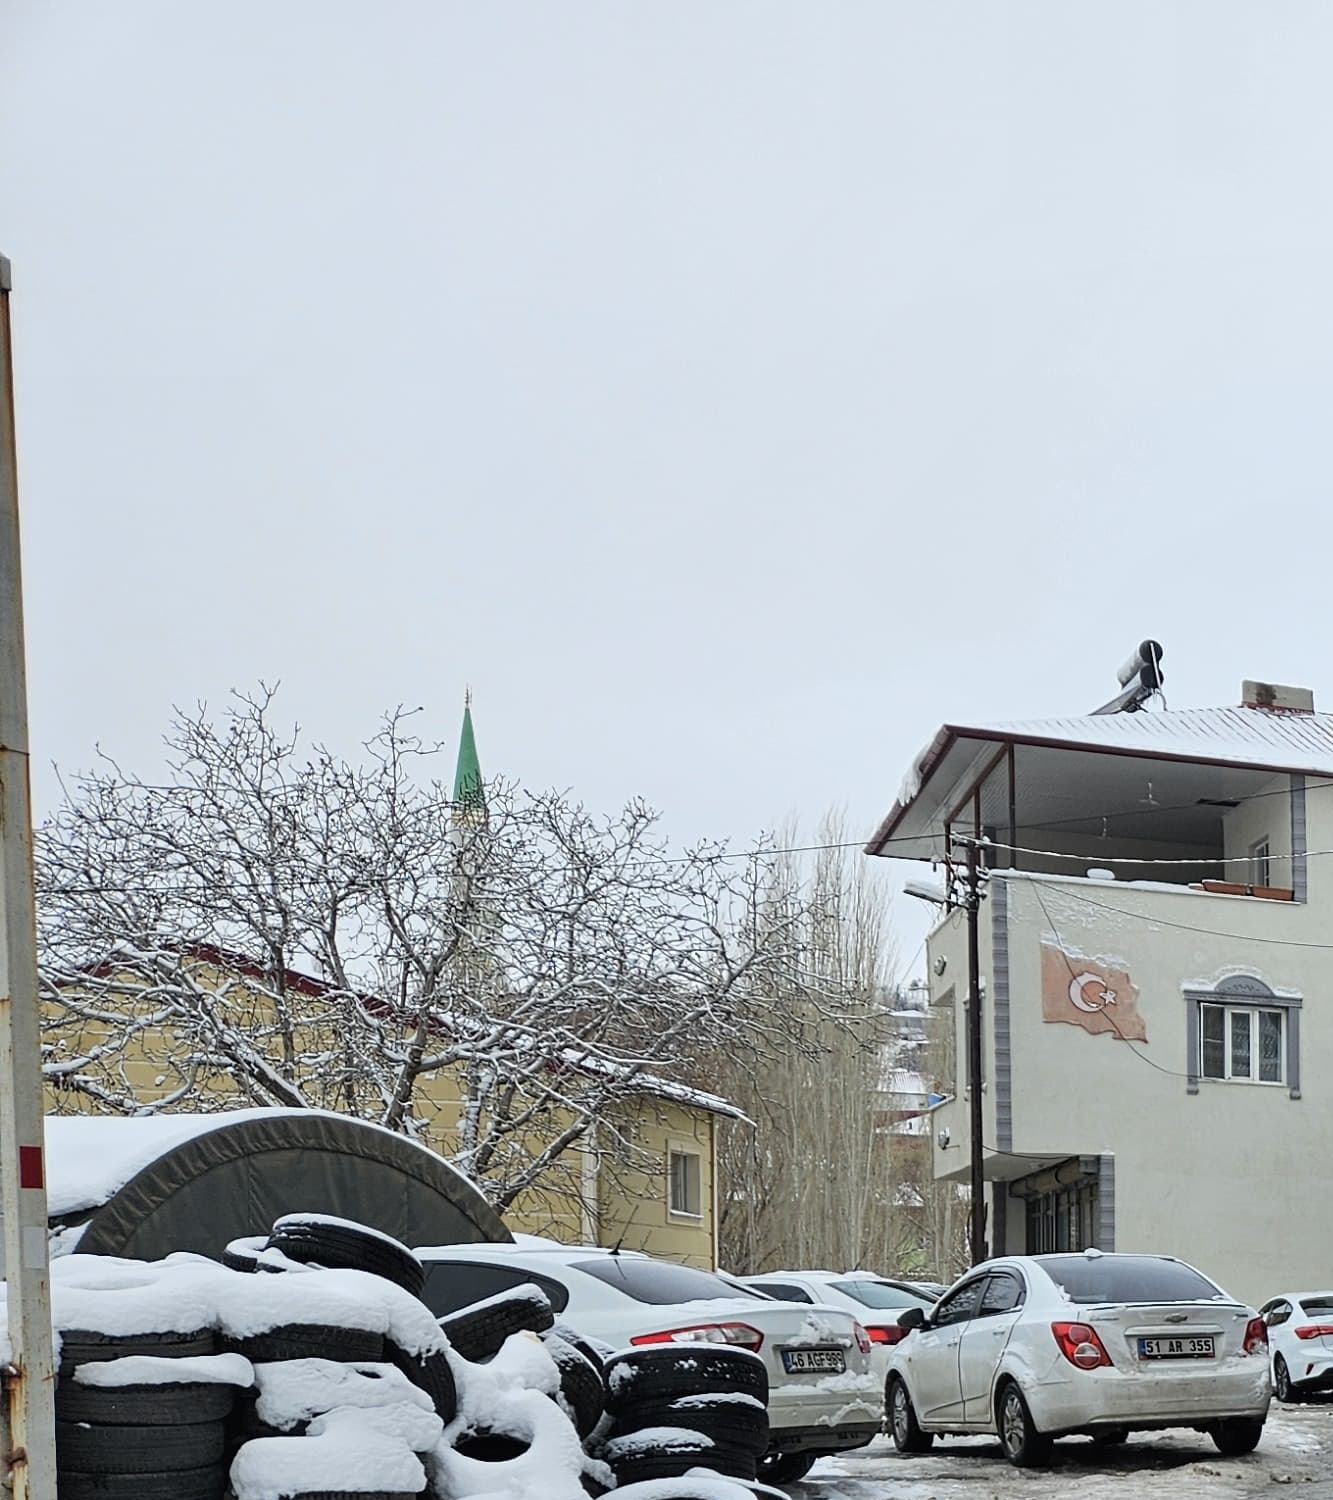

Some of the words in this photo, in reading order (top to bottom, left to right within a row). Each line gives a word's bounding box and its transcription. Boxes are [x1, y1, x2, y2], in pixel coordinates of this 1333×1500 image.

[1146, 1340, 1161, 1353] 51
[1168, 1340, 1183, 1353] AR
[1189, 1339, 1212, 1352] 355
[791, 1352, 805, 1367] 46
